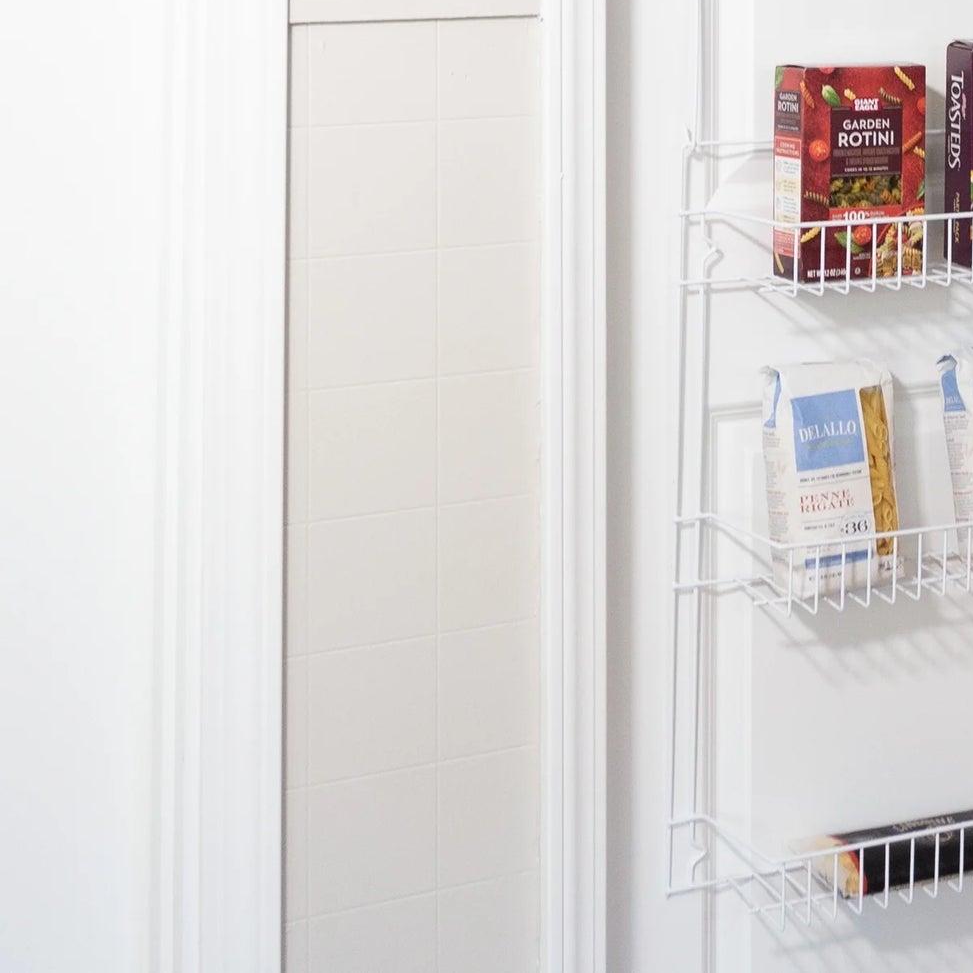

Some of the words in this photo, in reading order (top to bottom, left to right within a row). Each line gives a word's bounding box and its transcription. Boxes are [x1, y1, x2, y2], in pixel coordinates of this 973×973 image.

[777, 100, 799, 113] ROTINI
[854, 98, 879, 106] GIANT
[842, 117, 890, 130] GARDEN
[948, 70, 964, 169] TOASTEDS
[838, 130, 894, 147] ROTINI
[799, 420, 857, 443] DELALLO
[800, 488, 851, 504] PENNE
[800, 497, 855, 513] RIGATE
